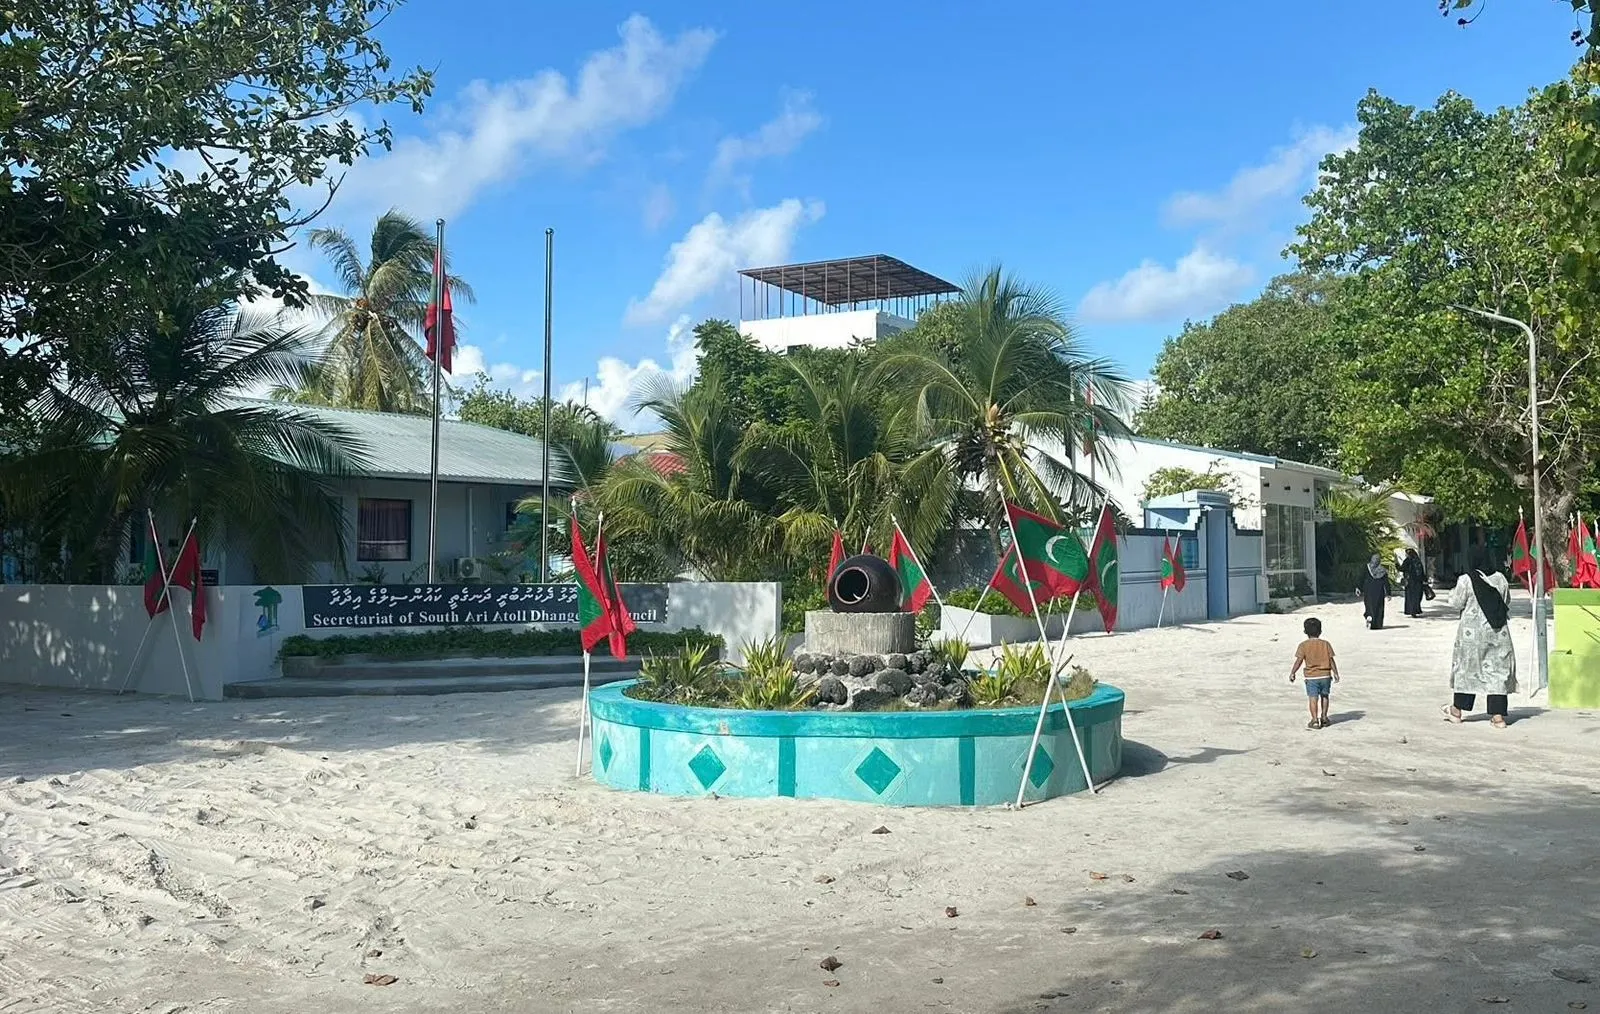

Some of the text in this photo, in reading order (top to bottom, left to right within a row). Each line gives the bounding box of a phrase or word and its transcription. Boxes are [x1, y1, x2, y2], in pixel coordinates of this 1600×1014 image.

[329, 587, 362, 610] އިދާރާ
[313, 609, 657, 627] Secretariat of South Ari Atoll Dhange ncil
